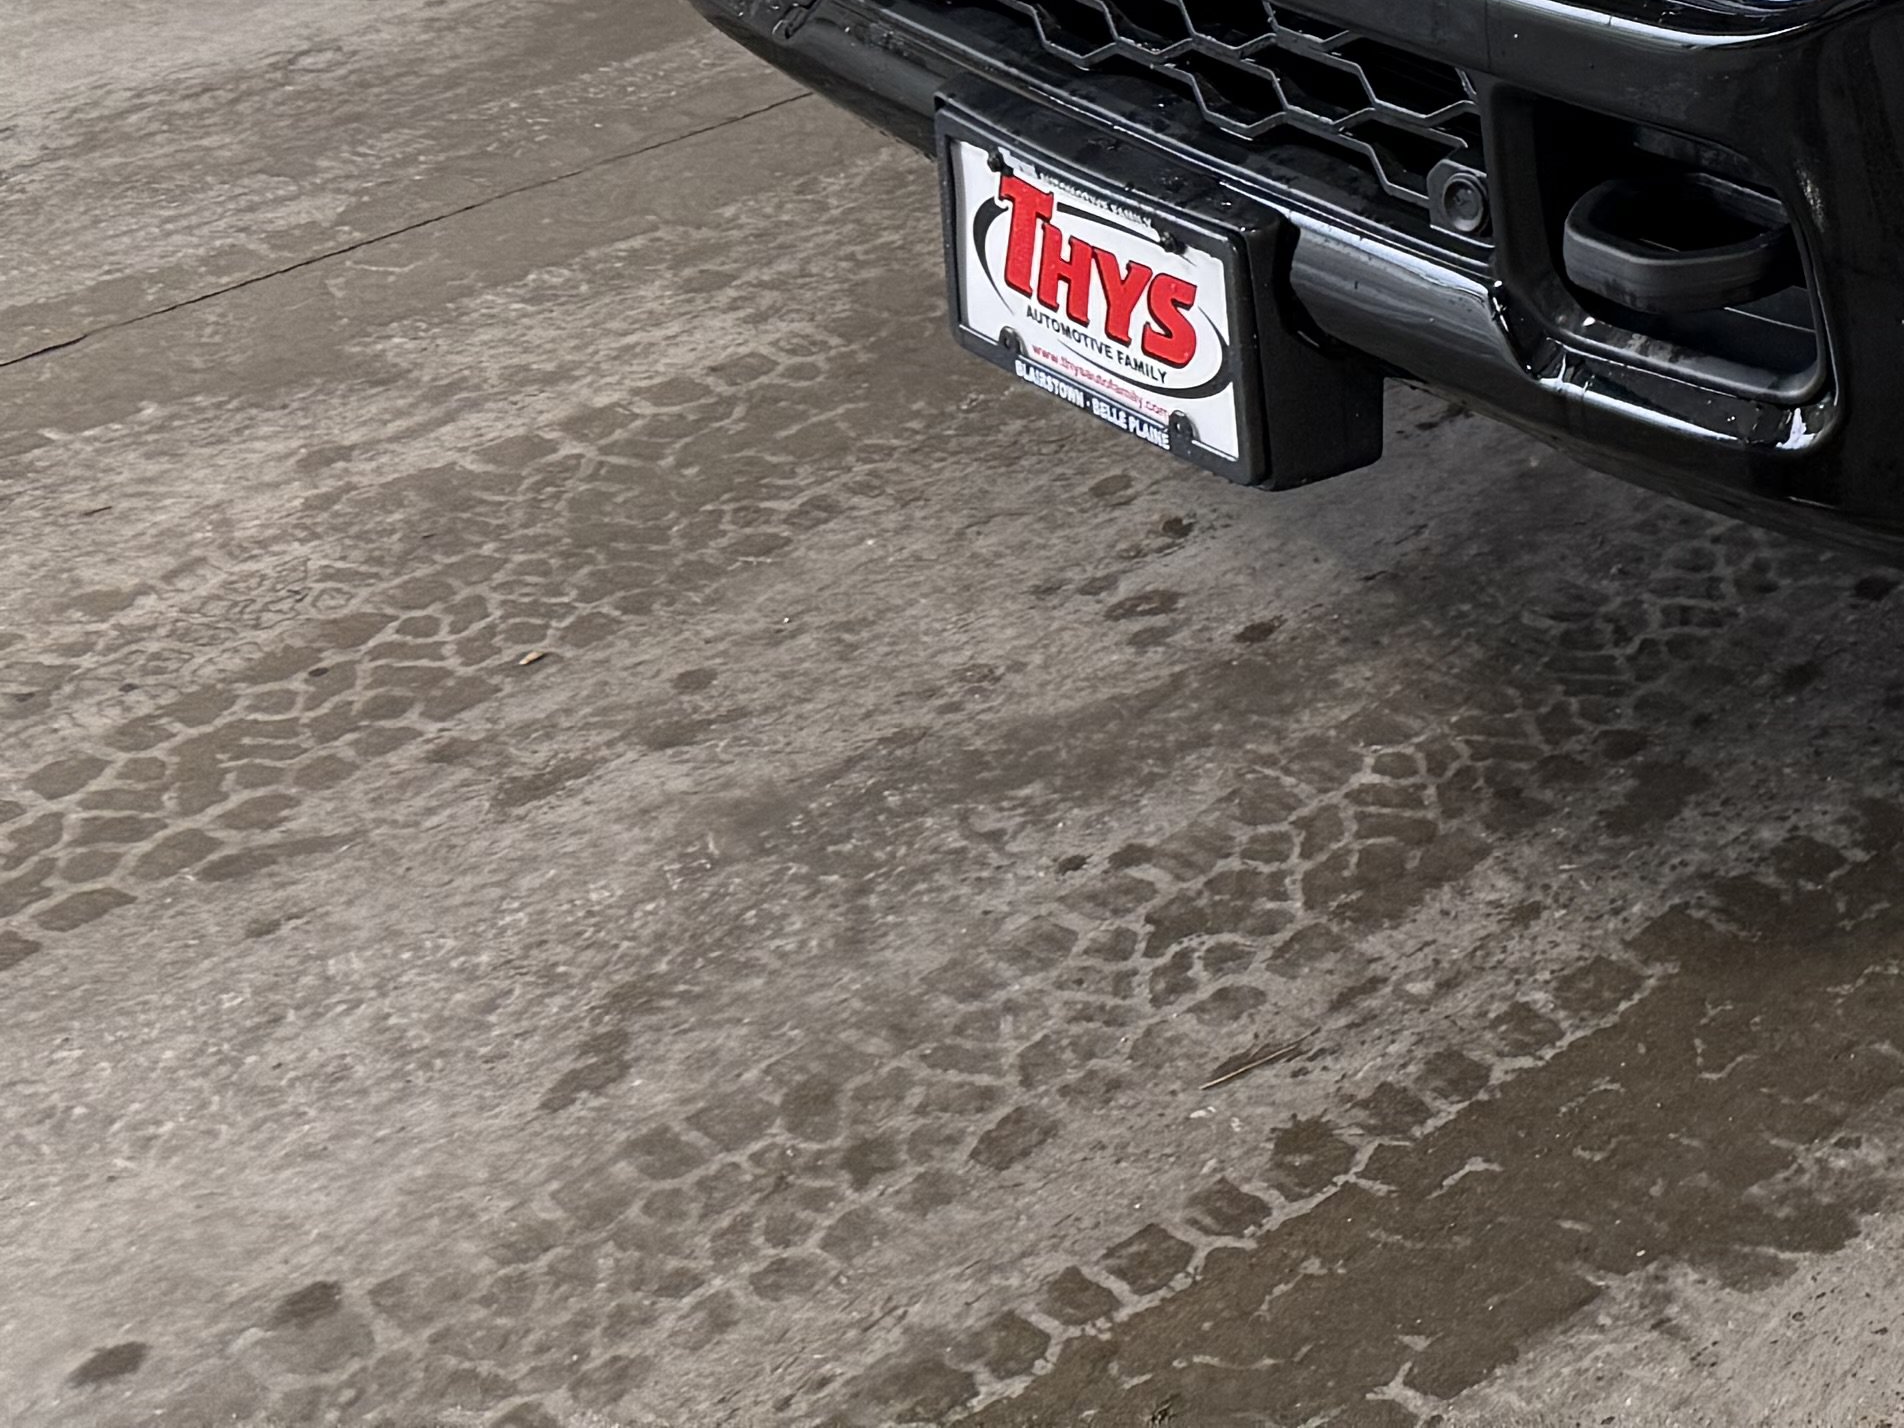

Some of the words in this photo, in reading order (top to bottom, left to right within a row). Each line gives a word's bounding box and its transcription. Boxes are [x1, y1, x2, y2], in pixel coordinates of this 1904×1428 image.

[998, 172, 1198, 369] THYS
[1026, 305, 1114, 360] AUTOMOTIVE
[1116, 349, 1168, 385] FAMILY
[1015, 359, 1085, 409] BLAIRSTOWN
[1092, 397, 1128, 430] BELLE
[1128, 415, 1171, 451] PLAINE
